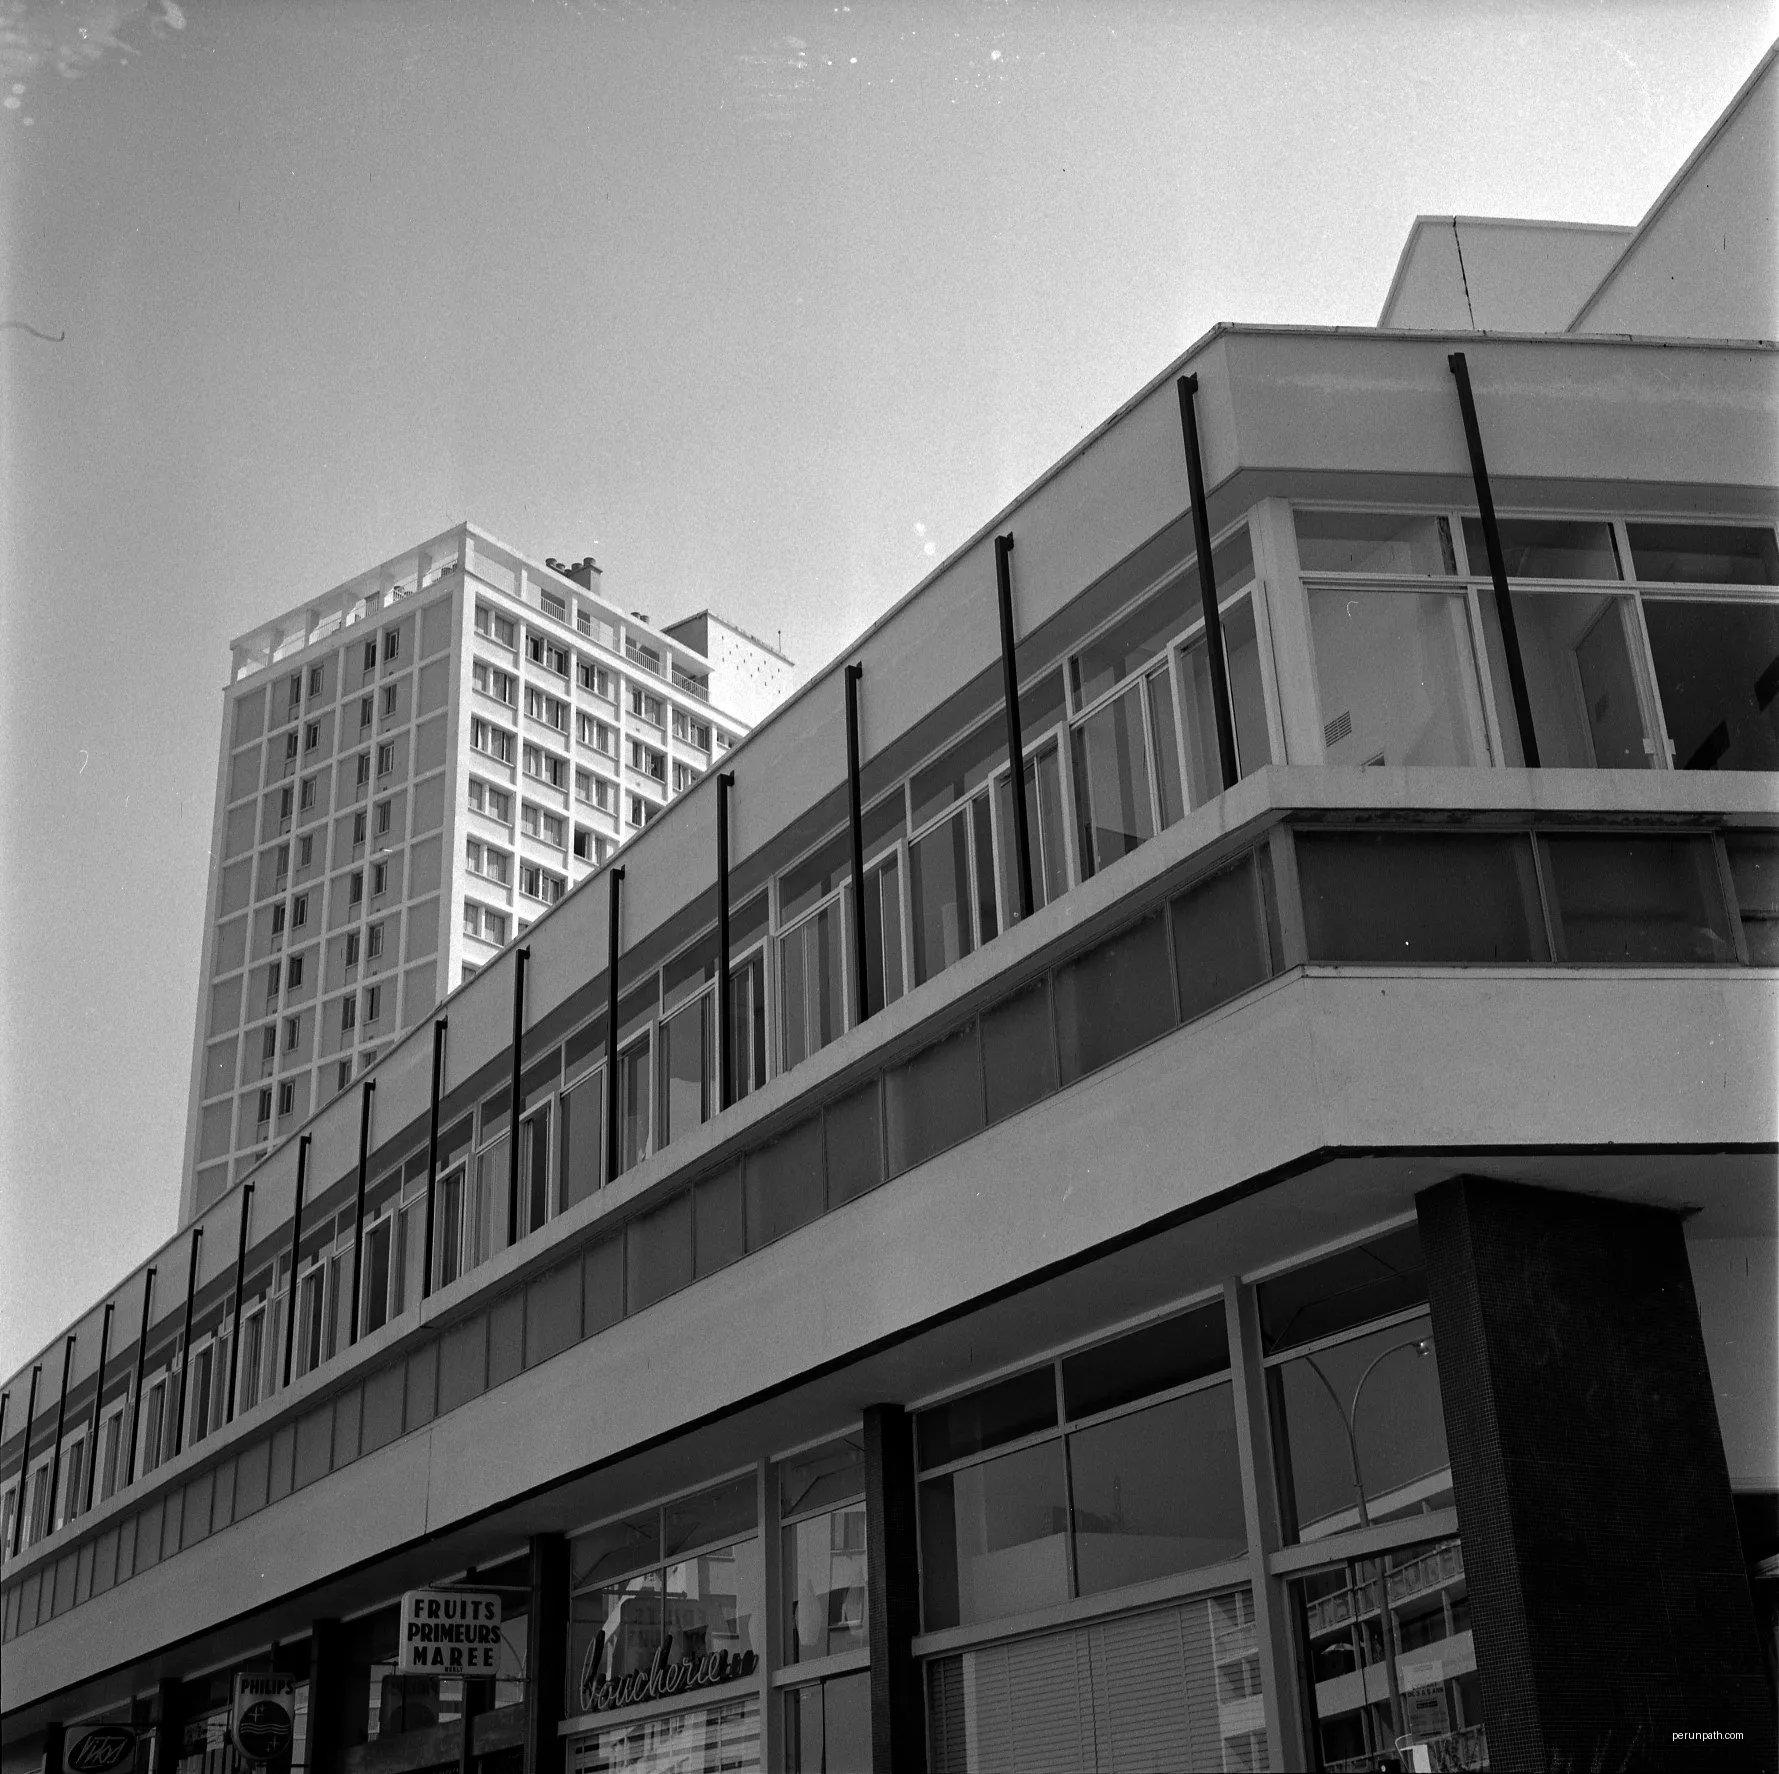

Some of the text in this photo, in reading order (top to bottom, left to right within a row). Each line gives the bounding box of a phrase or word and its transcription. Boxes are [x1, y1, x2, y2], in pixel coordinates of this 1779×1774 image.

[414, 1599, 495, 1620] FRUITS
[408, 1622, 501, 1644] PRIMEURS
[413, 1646, 494, 1666] MAREE
[580, 1635, 724, 1712] boucherie
[241, 1679, 294, 1695] PHILIPS
